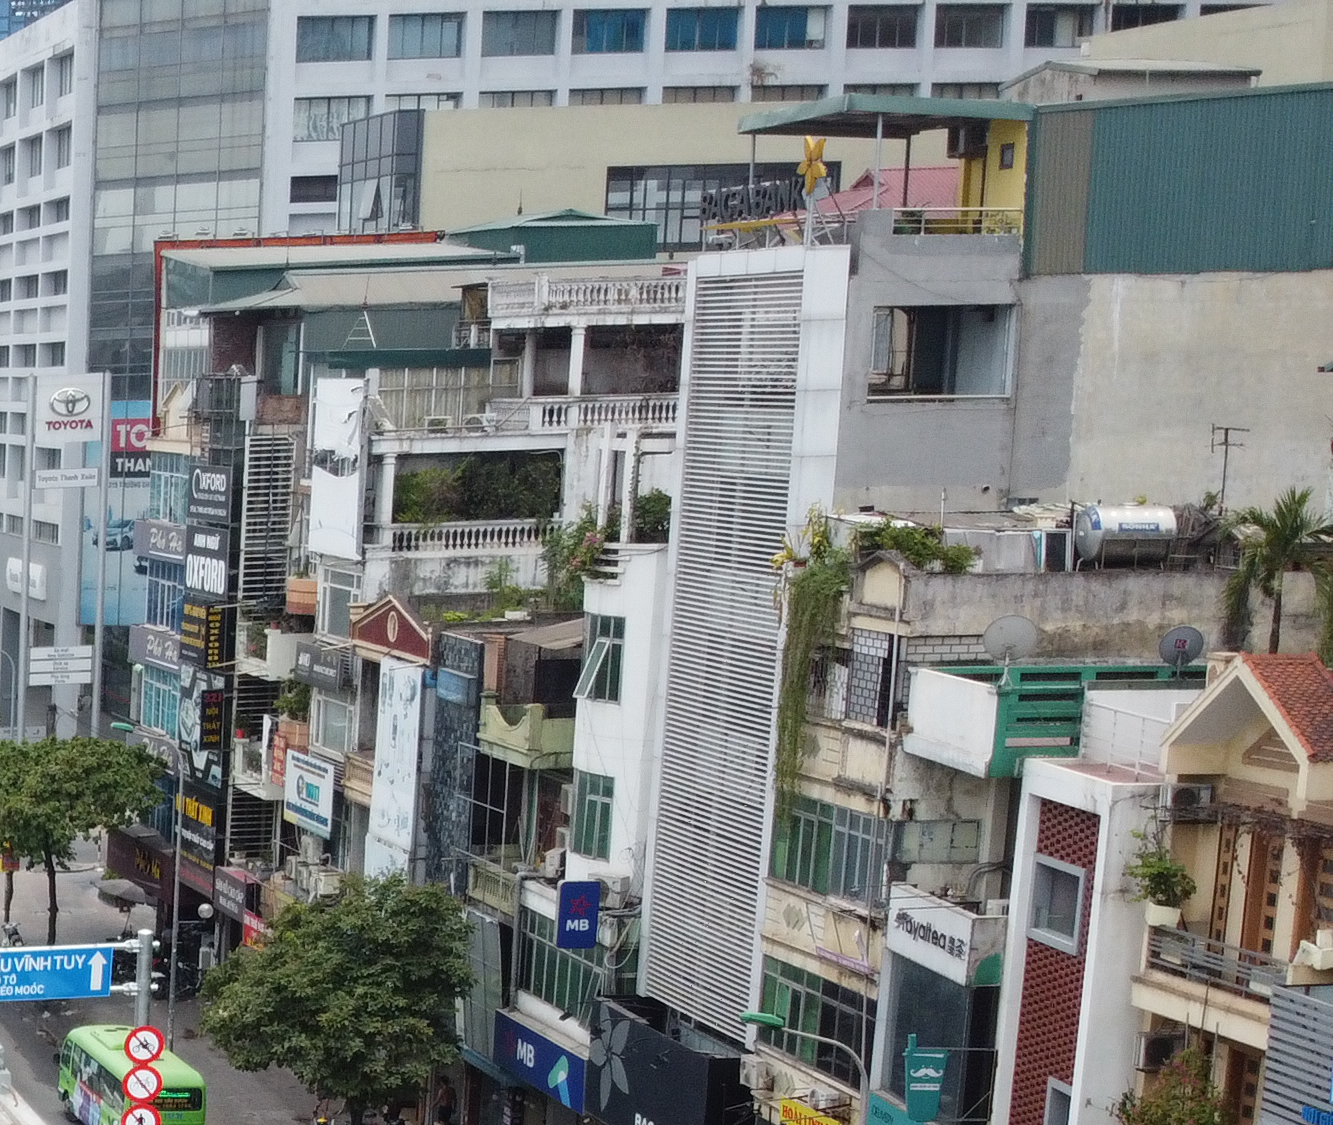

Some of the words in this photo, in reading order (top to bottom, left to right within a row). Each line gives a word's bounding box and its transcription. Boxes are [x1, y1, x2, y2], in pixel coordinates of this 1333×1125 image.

[45, 420, 93, 431] TOYOTA
[186, 554, 225, 595] OXFORD
[566, 919, 589, 931] MB
[14, 954, 52, 972] VĨNH
[53, 954, 86, 971] TUY
[3, 973, 17, 985] TÔ
[516, 1039, 534, 1068] MB
